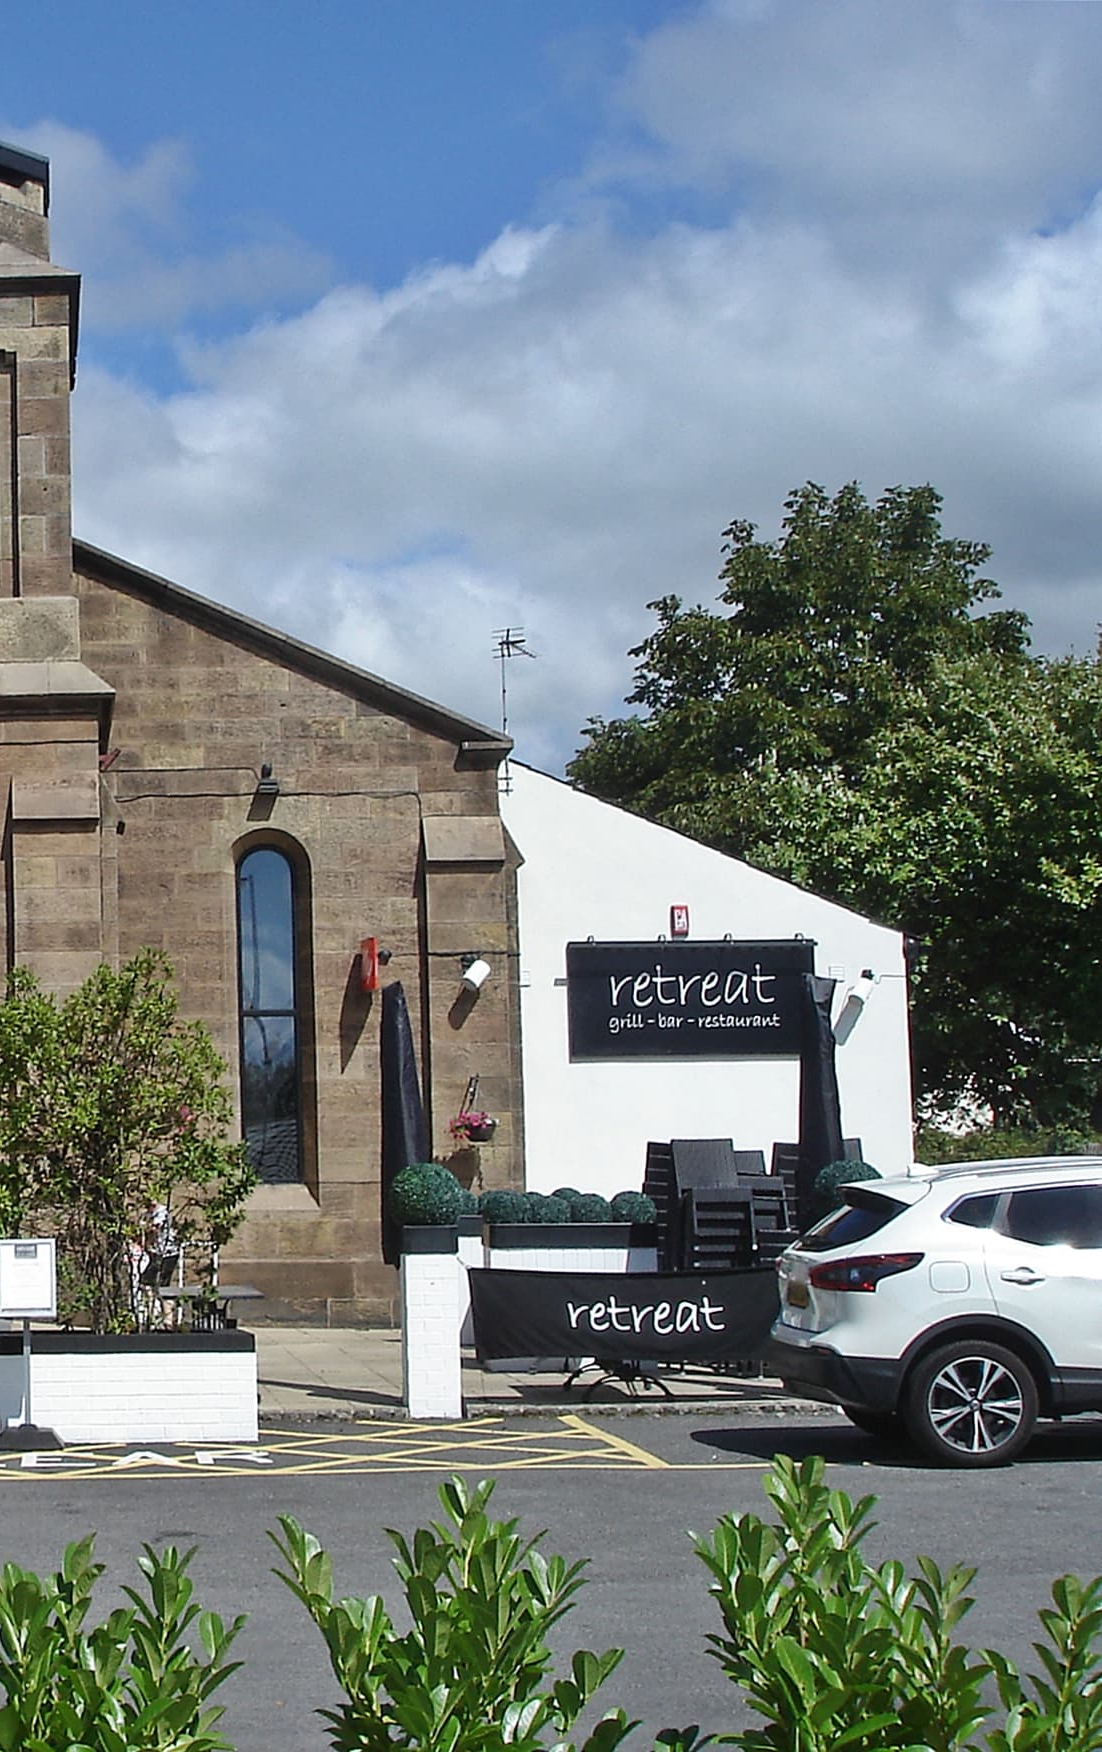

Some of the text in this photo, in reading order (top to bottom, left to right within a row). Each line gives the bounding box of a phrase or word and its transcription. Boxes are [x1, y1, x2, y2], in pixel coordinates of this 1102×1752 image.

[609, 964, 776, 1007] retreat
[608, 1013, 645, 1034] grill
[658, 1013, 684, 1029] bar
[698, 1012, 781, 1029] restaurant
[567, 1296, 725, 1334] retreat
